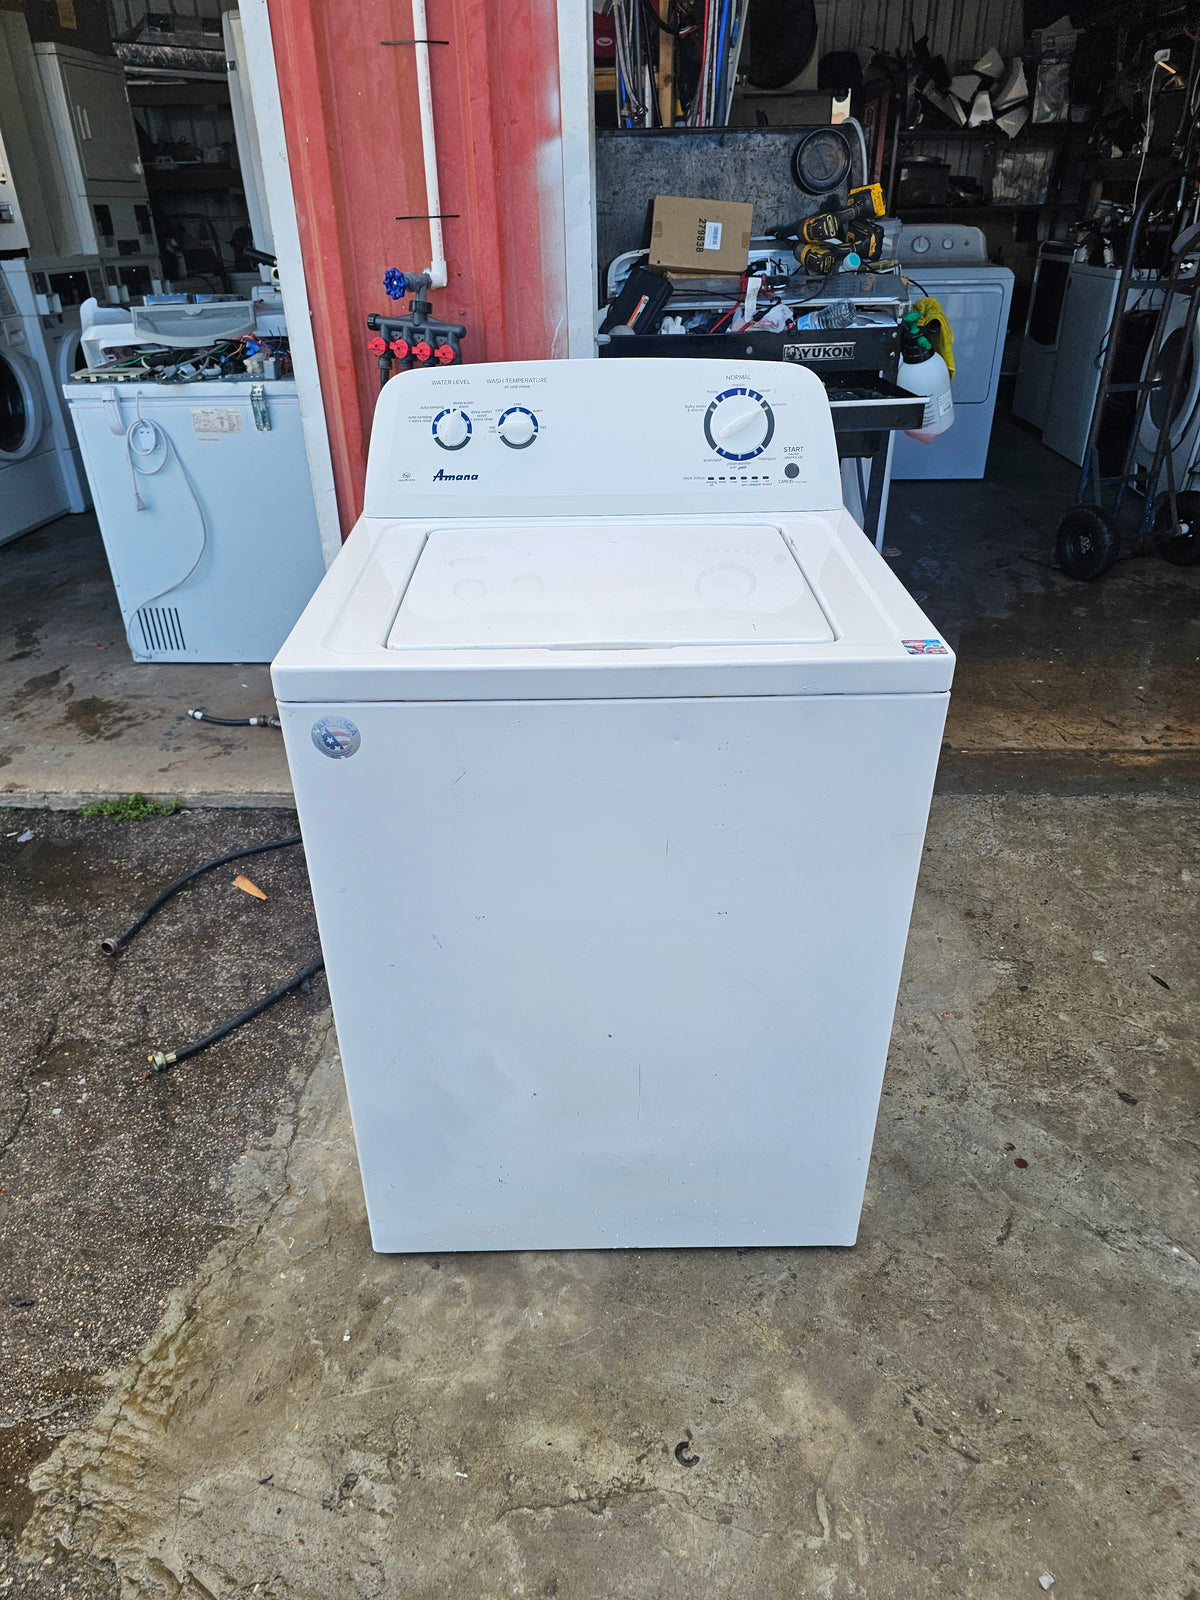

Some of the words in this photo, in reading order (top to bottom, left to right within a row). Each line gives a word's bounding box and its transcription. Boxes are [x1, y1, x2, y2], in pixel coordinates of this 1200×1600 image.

[695, 218, 707, 253] 279838
[801, 346, 853, 358] YUKON
[432, 469, 479, 482] Amana
[317, 716, 357, 737] AMRICA
